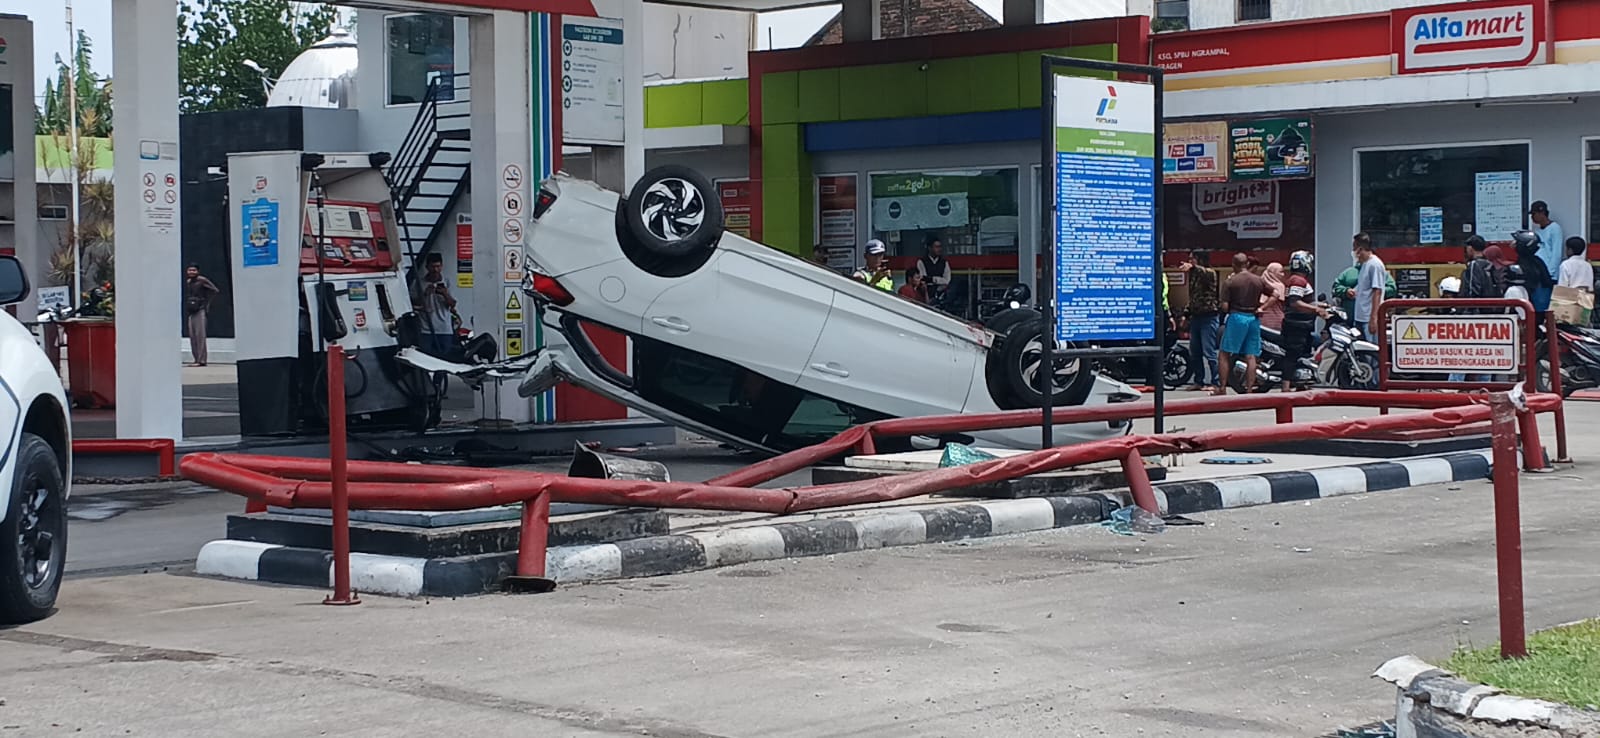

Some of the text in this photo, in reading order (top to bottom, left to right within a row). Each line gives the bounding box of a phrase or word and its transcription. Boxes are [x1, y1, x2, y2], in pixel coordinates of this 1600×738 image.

[1413, 11, 1525, 40] Alfamart
[1428, 323, 1510, 339] PERHATIAN
[1405, 347, 1437, 356] DILARANG
[1439, 348, 1462, 356] MASUK
[1465, 348, 1473, 356] KE
[1475, 348, 1493, 356] AREA
[1399, 358, 1424, 366] SEDANG
[1426, 358, 1439, 366] ADA
